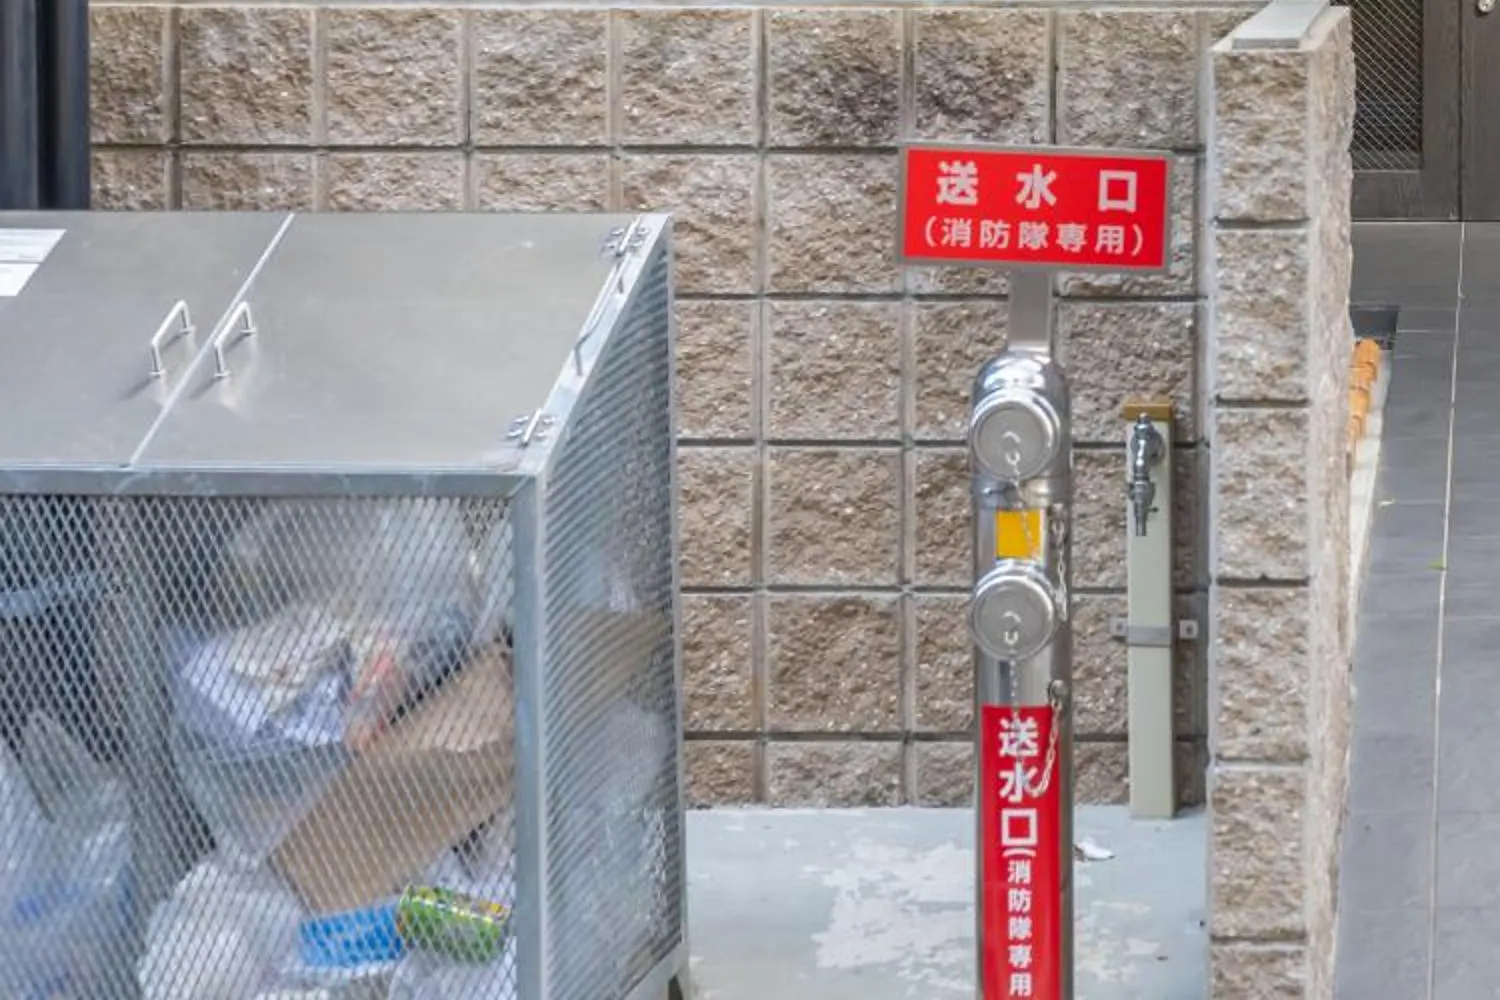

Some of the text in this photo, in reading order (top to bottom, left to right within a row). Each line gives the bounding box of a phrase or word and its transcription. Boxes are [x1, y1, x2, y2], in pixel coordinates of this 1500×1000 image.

[936, 160, 1138, 213] 送水口
[998, 716, 1039, 846] 送水口
